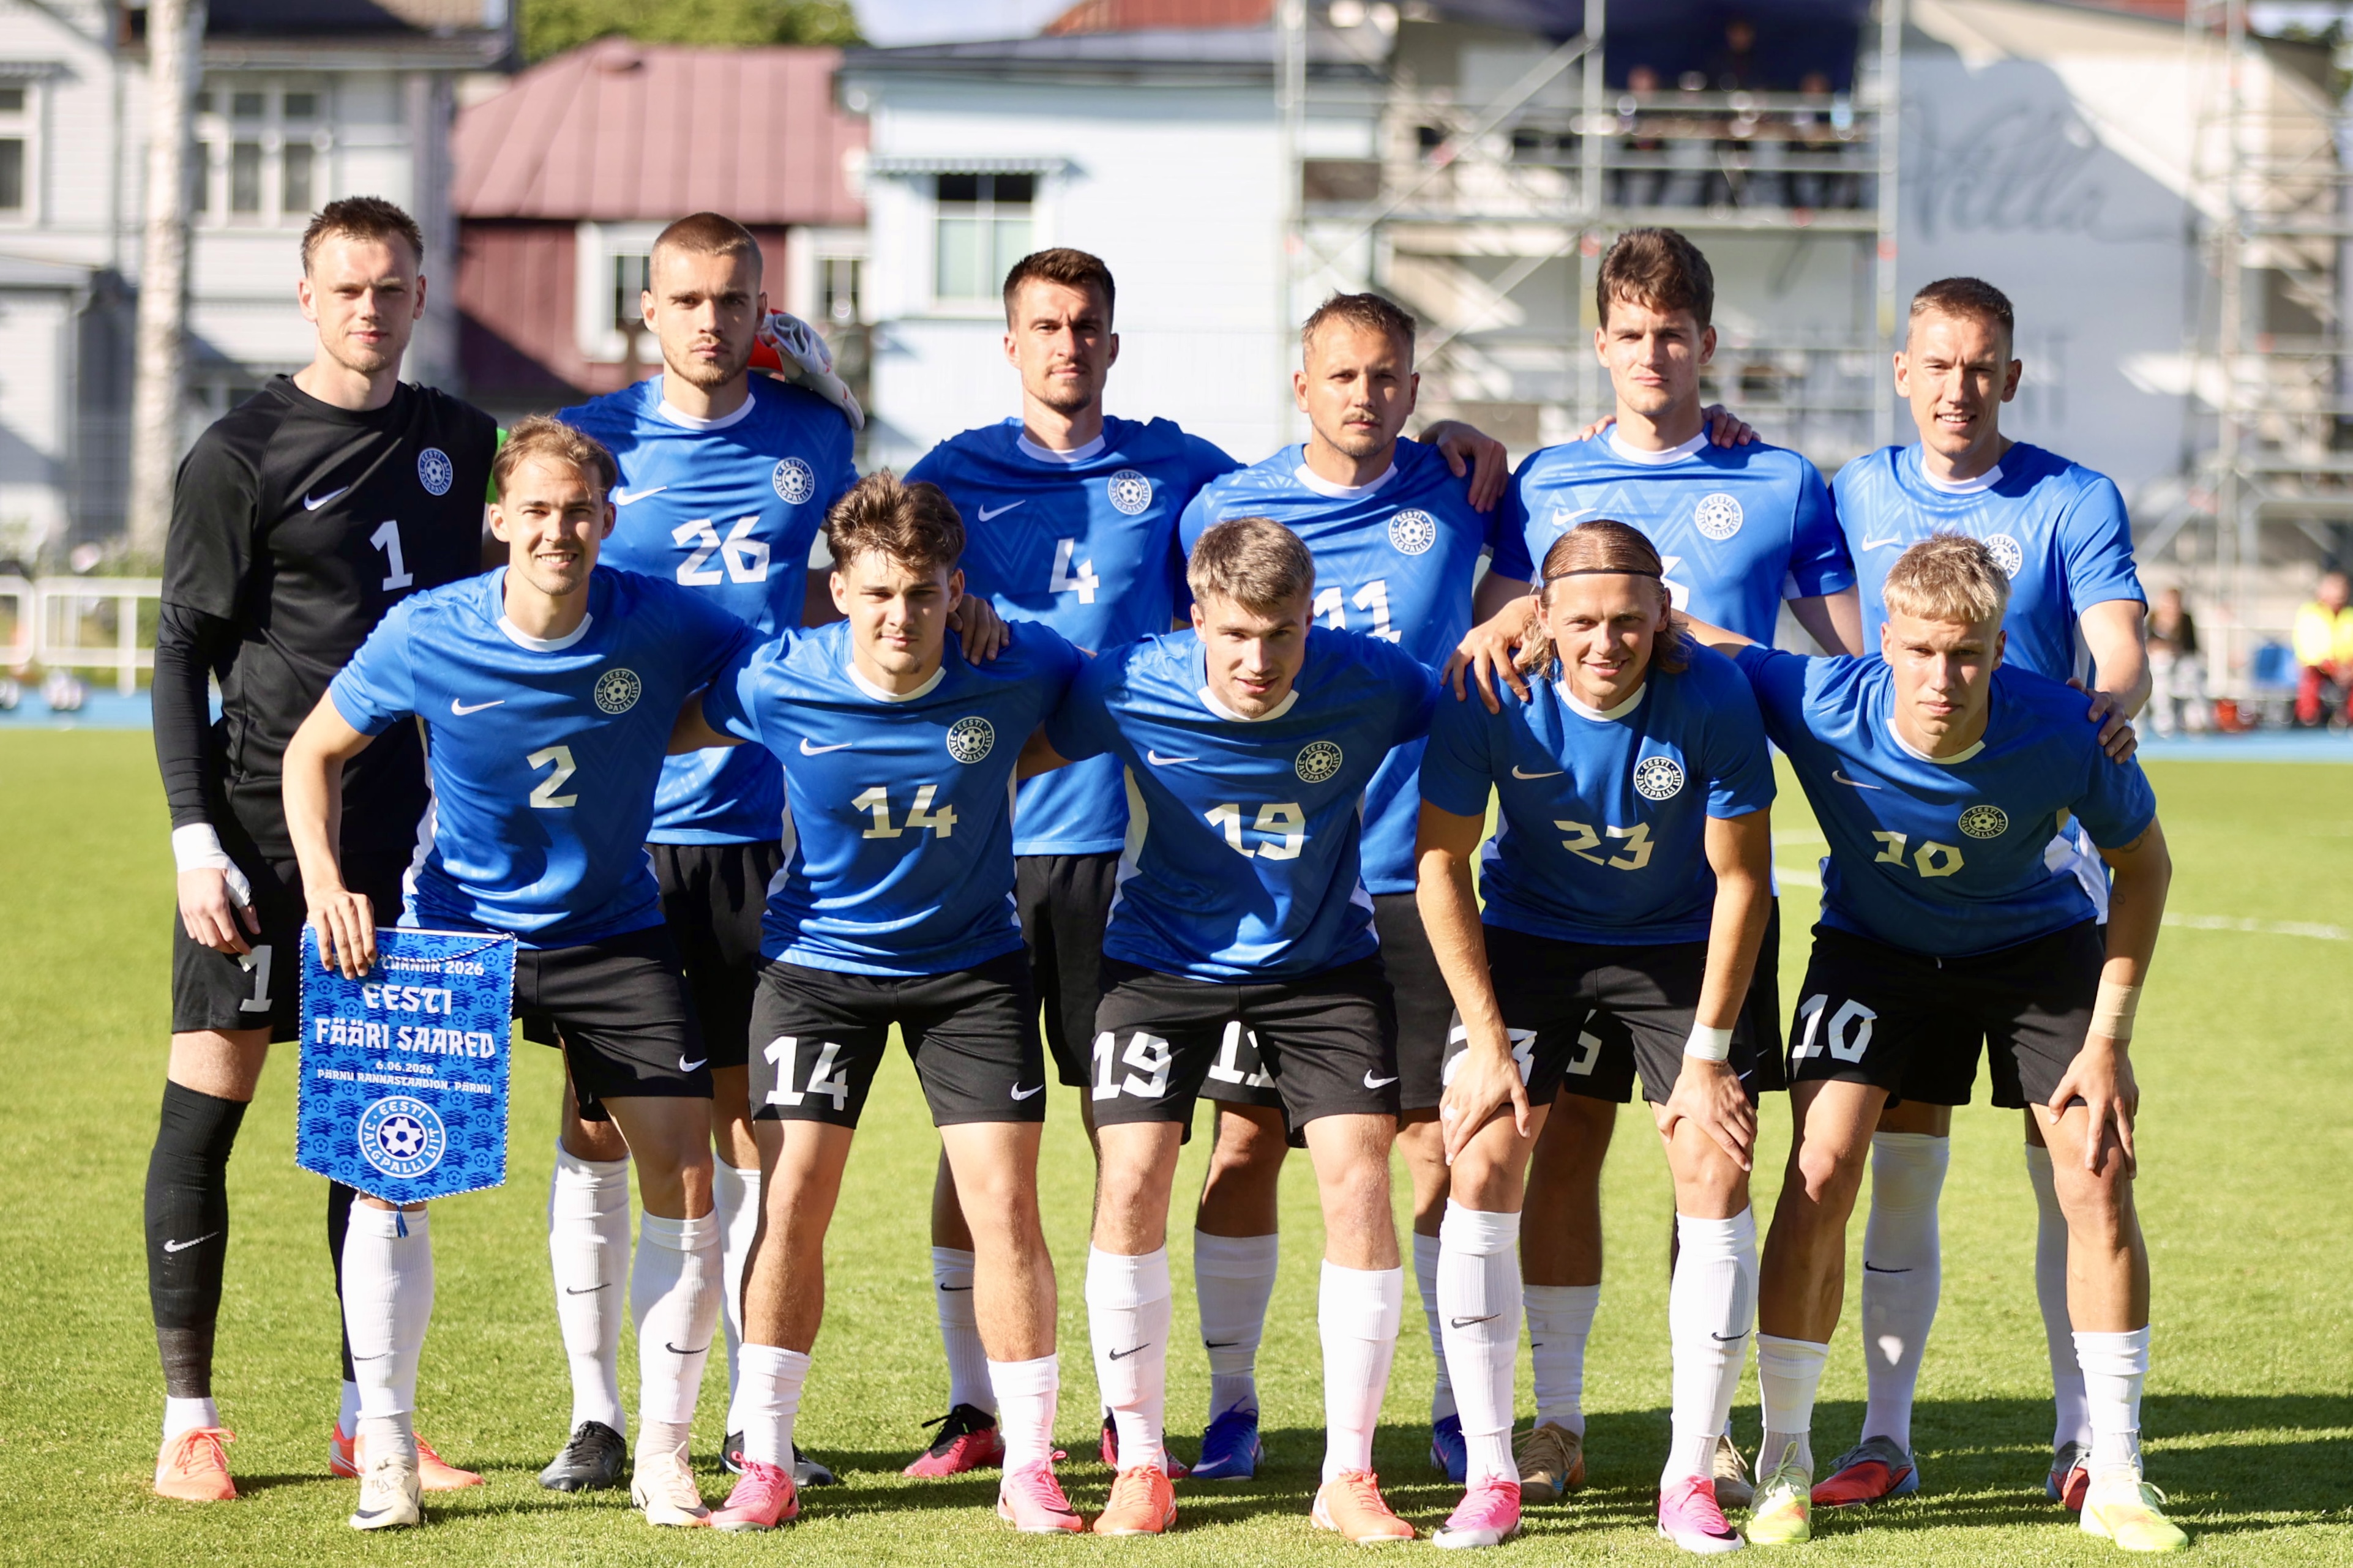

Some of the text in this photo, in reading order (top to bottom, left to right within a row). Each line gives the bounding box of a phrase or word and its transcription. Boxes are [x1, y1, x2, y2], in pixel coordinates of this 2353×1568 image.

[780, 460, 804, 471] EESTI
[774, 474, 809, 502] JALGPALLI
[1397, 510, 1423, 523] EESTI
[671, 516, 770, 586] 26
[1391, 523, 1434, 552] JALGPALLI LIIT
[370, 520, 413, 591] 1
[1049, 538, 1099, 604] 4
[604, 671, 629, 682] EESTI
[597, 680, 638, 712] JALGPALLI LIIT
[958, 719, 983, 731] EESTI
[949, 735, 985, 761] JALGPALLI
[1306, 744, 1332, 755] EESTI
[526, 745, 578, 808] 2
[1298, 752, 1340, 780] JALGPALLI LIIT
[1643, 758, 1670, 769] EESTI
[1637, 769, 1682, 797] JALGPALLI LIIT
[851, 785, 957, 838] 14
[1972, 807, 1999, 815] EESTI
[1204, 802, 1305, 861] 19
[1554, 820, 1655, 870] 23
[238, 945, 273, 1012] 1
[445, 960, 485, 976] 2026
[362, 983, 452, 1015] EESTI
[315, 1017, 496, 1059] FÄÄRI SAARED
[1792, 994, 1877, 1063] 10
[375, 1060, 433, 1075] 6.06.2026
[763, 1036, 848, 1111] 14
[1092, 1031, 1172, 1101] 19
[317, 1069, 492, 1094] PÄRNU RANNASTAADION, PÄRNU
[378, 1101, 427, 1119] EESTI
[364, 1122, 441, 1173] JALGPALLI LIIT
